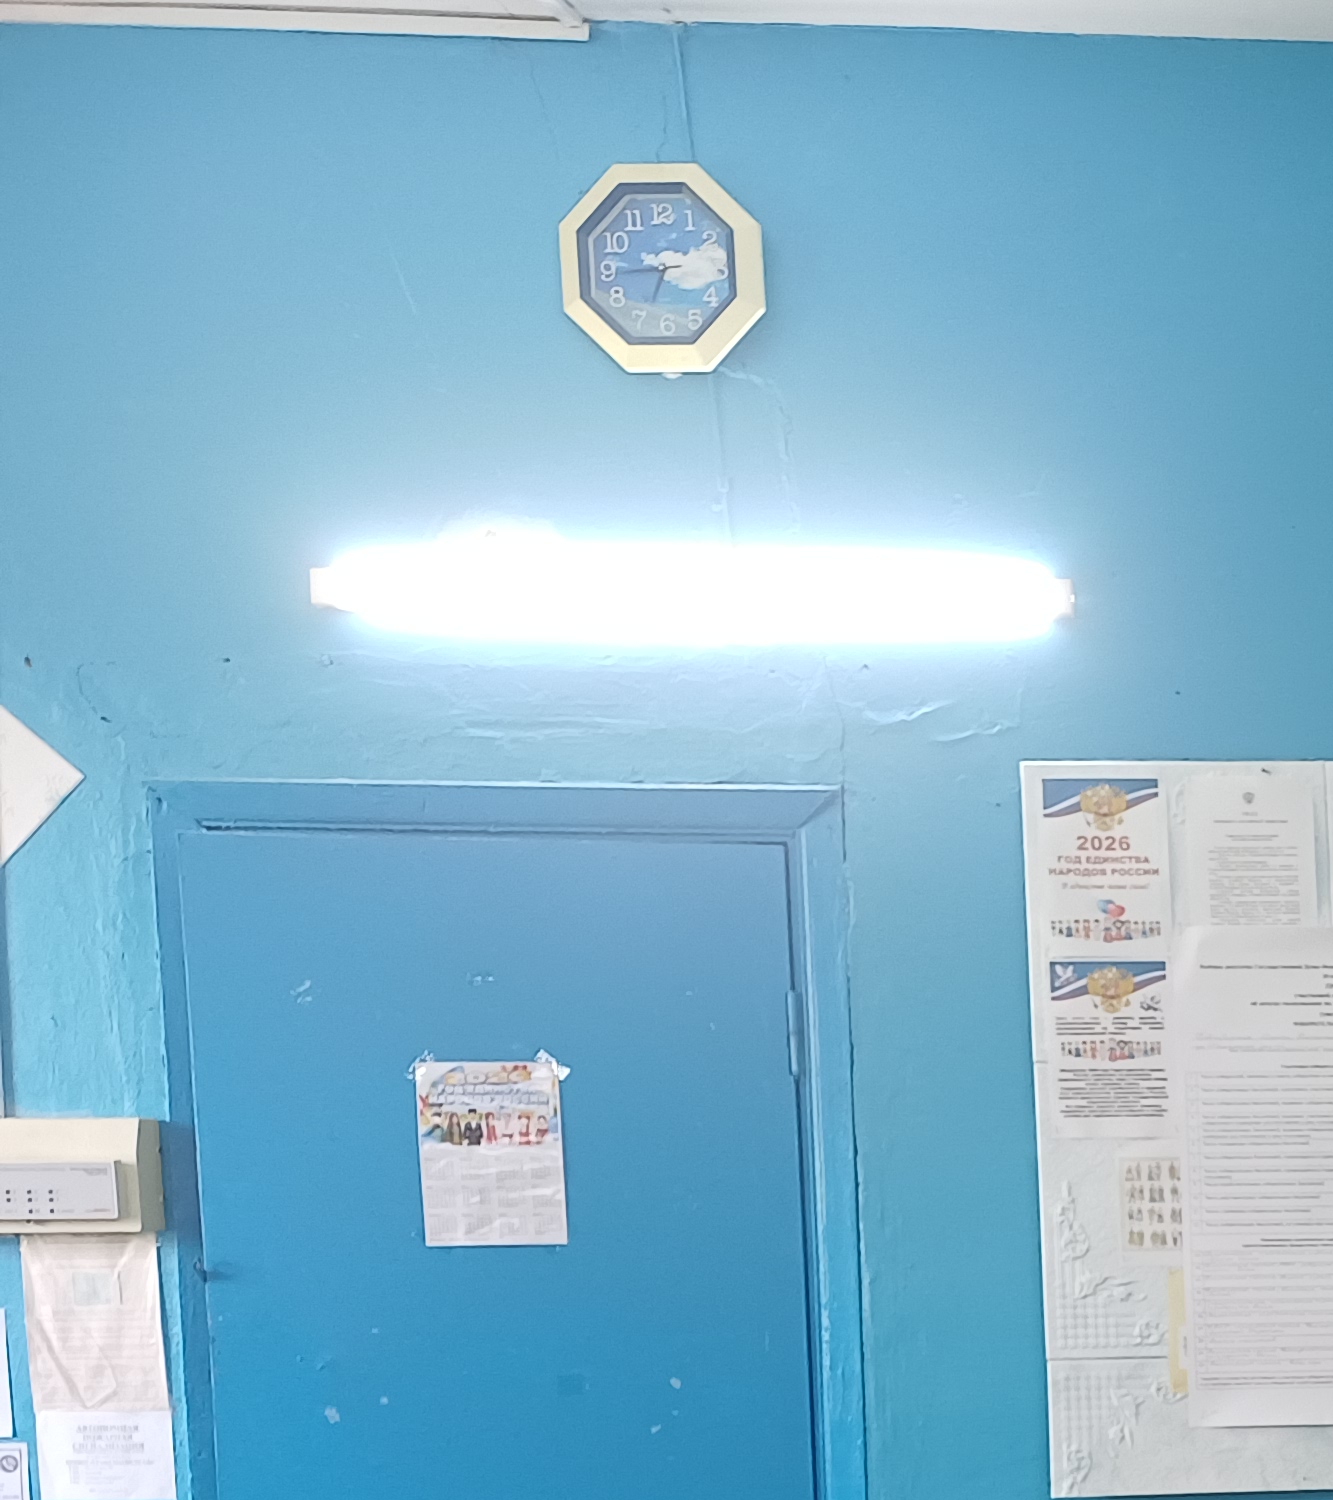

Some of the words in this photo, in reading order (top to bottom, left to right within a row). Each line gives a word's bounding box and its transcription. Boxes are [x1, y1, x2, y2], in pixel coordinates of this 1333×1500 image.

[623, 209, 645, 232] 11
[649, 203, 674, 225] 12
[683, 209, 697, 231] 1
[603, 231, 629, 254] 10
[600, 261, 617, 281] 9
[609, 286, 626, 308] 8
[702, 286, 720, 308] 4
[631, 309, 647, 330] 7
[661, 313, 676, 336] 6
[687, 309, 703, 331] 5
[1076, 835, 1131, 851] 2026
[1057, 855, 1082, 865] ГОД
[1085, 855, 1151, 865] ЕДИНСТВА
[1048, 868, 1107, 877] НАРОДОВ
[1110, 868, 1160, 877] РОССИИ
